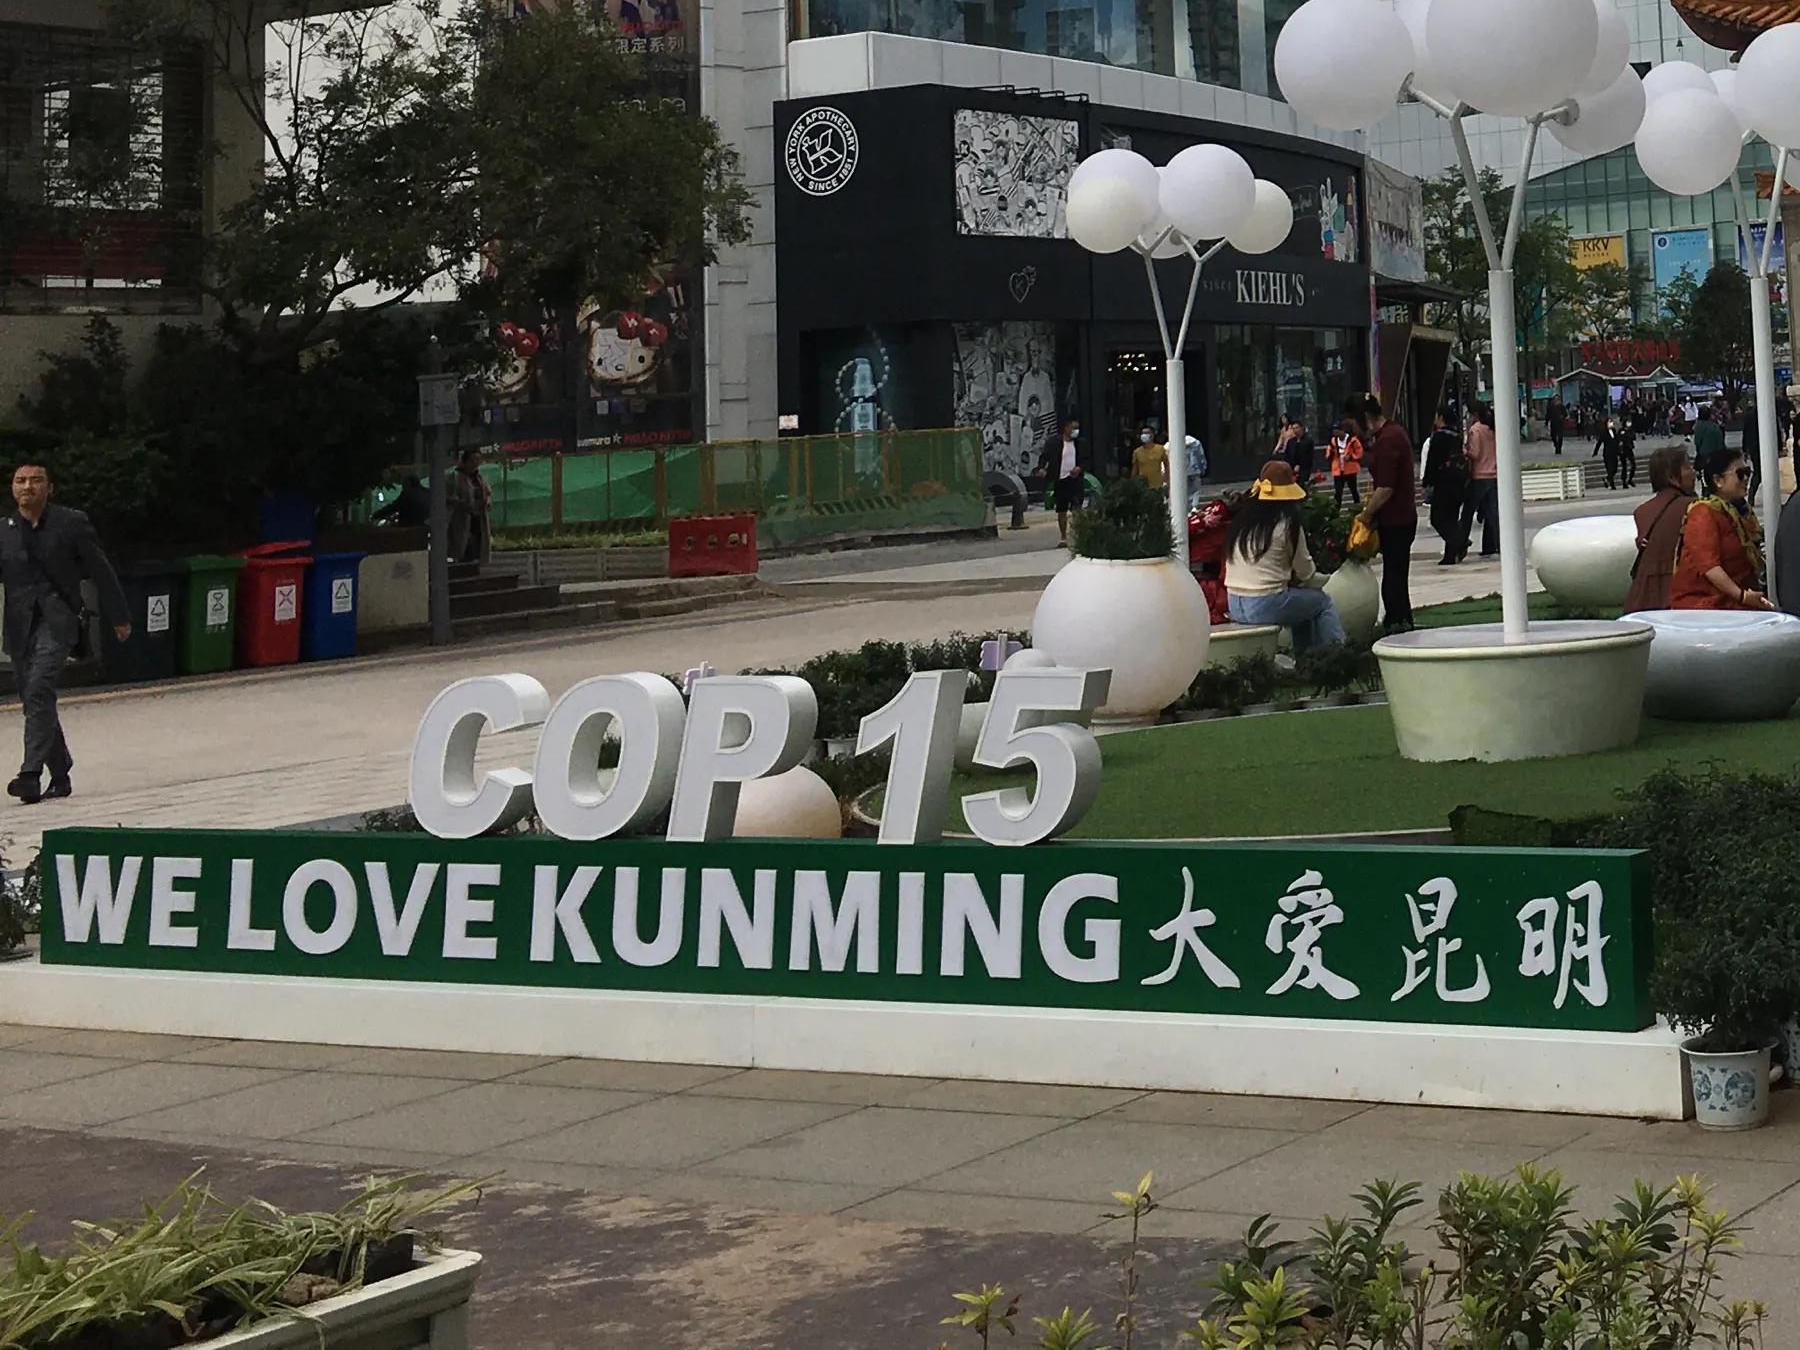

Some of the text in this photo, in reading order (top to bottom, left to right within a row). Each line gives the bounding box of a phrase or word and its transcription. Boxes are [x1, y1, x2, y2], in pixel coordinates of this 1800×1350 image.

[789, 111, 856, 182] NEW YORK APOTHECARY
[808, 178, 839, 191] SINCE
[1582, 237, 1610, 252] KKV
[1236, 270, 1305, 306] KIEHL'S
[410, 667, 1113, 847] COP 15
[55, 854, 1610, 1010] WE LOVE KUNMING 大爱昆明
